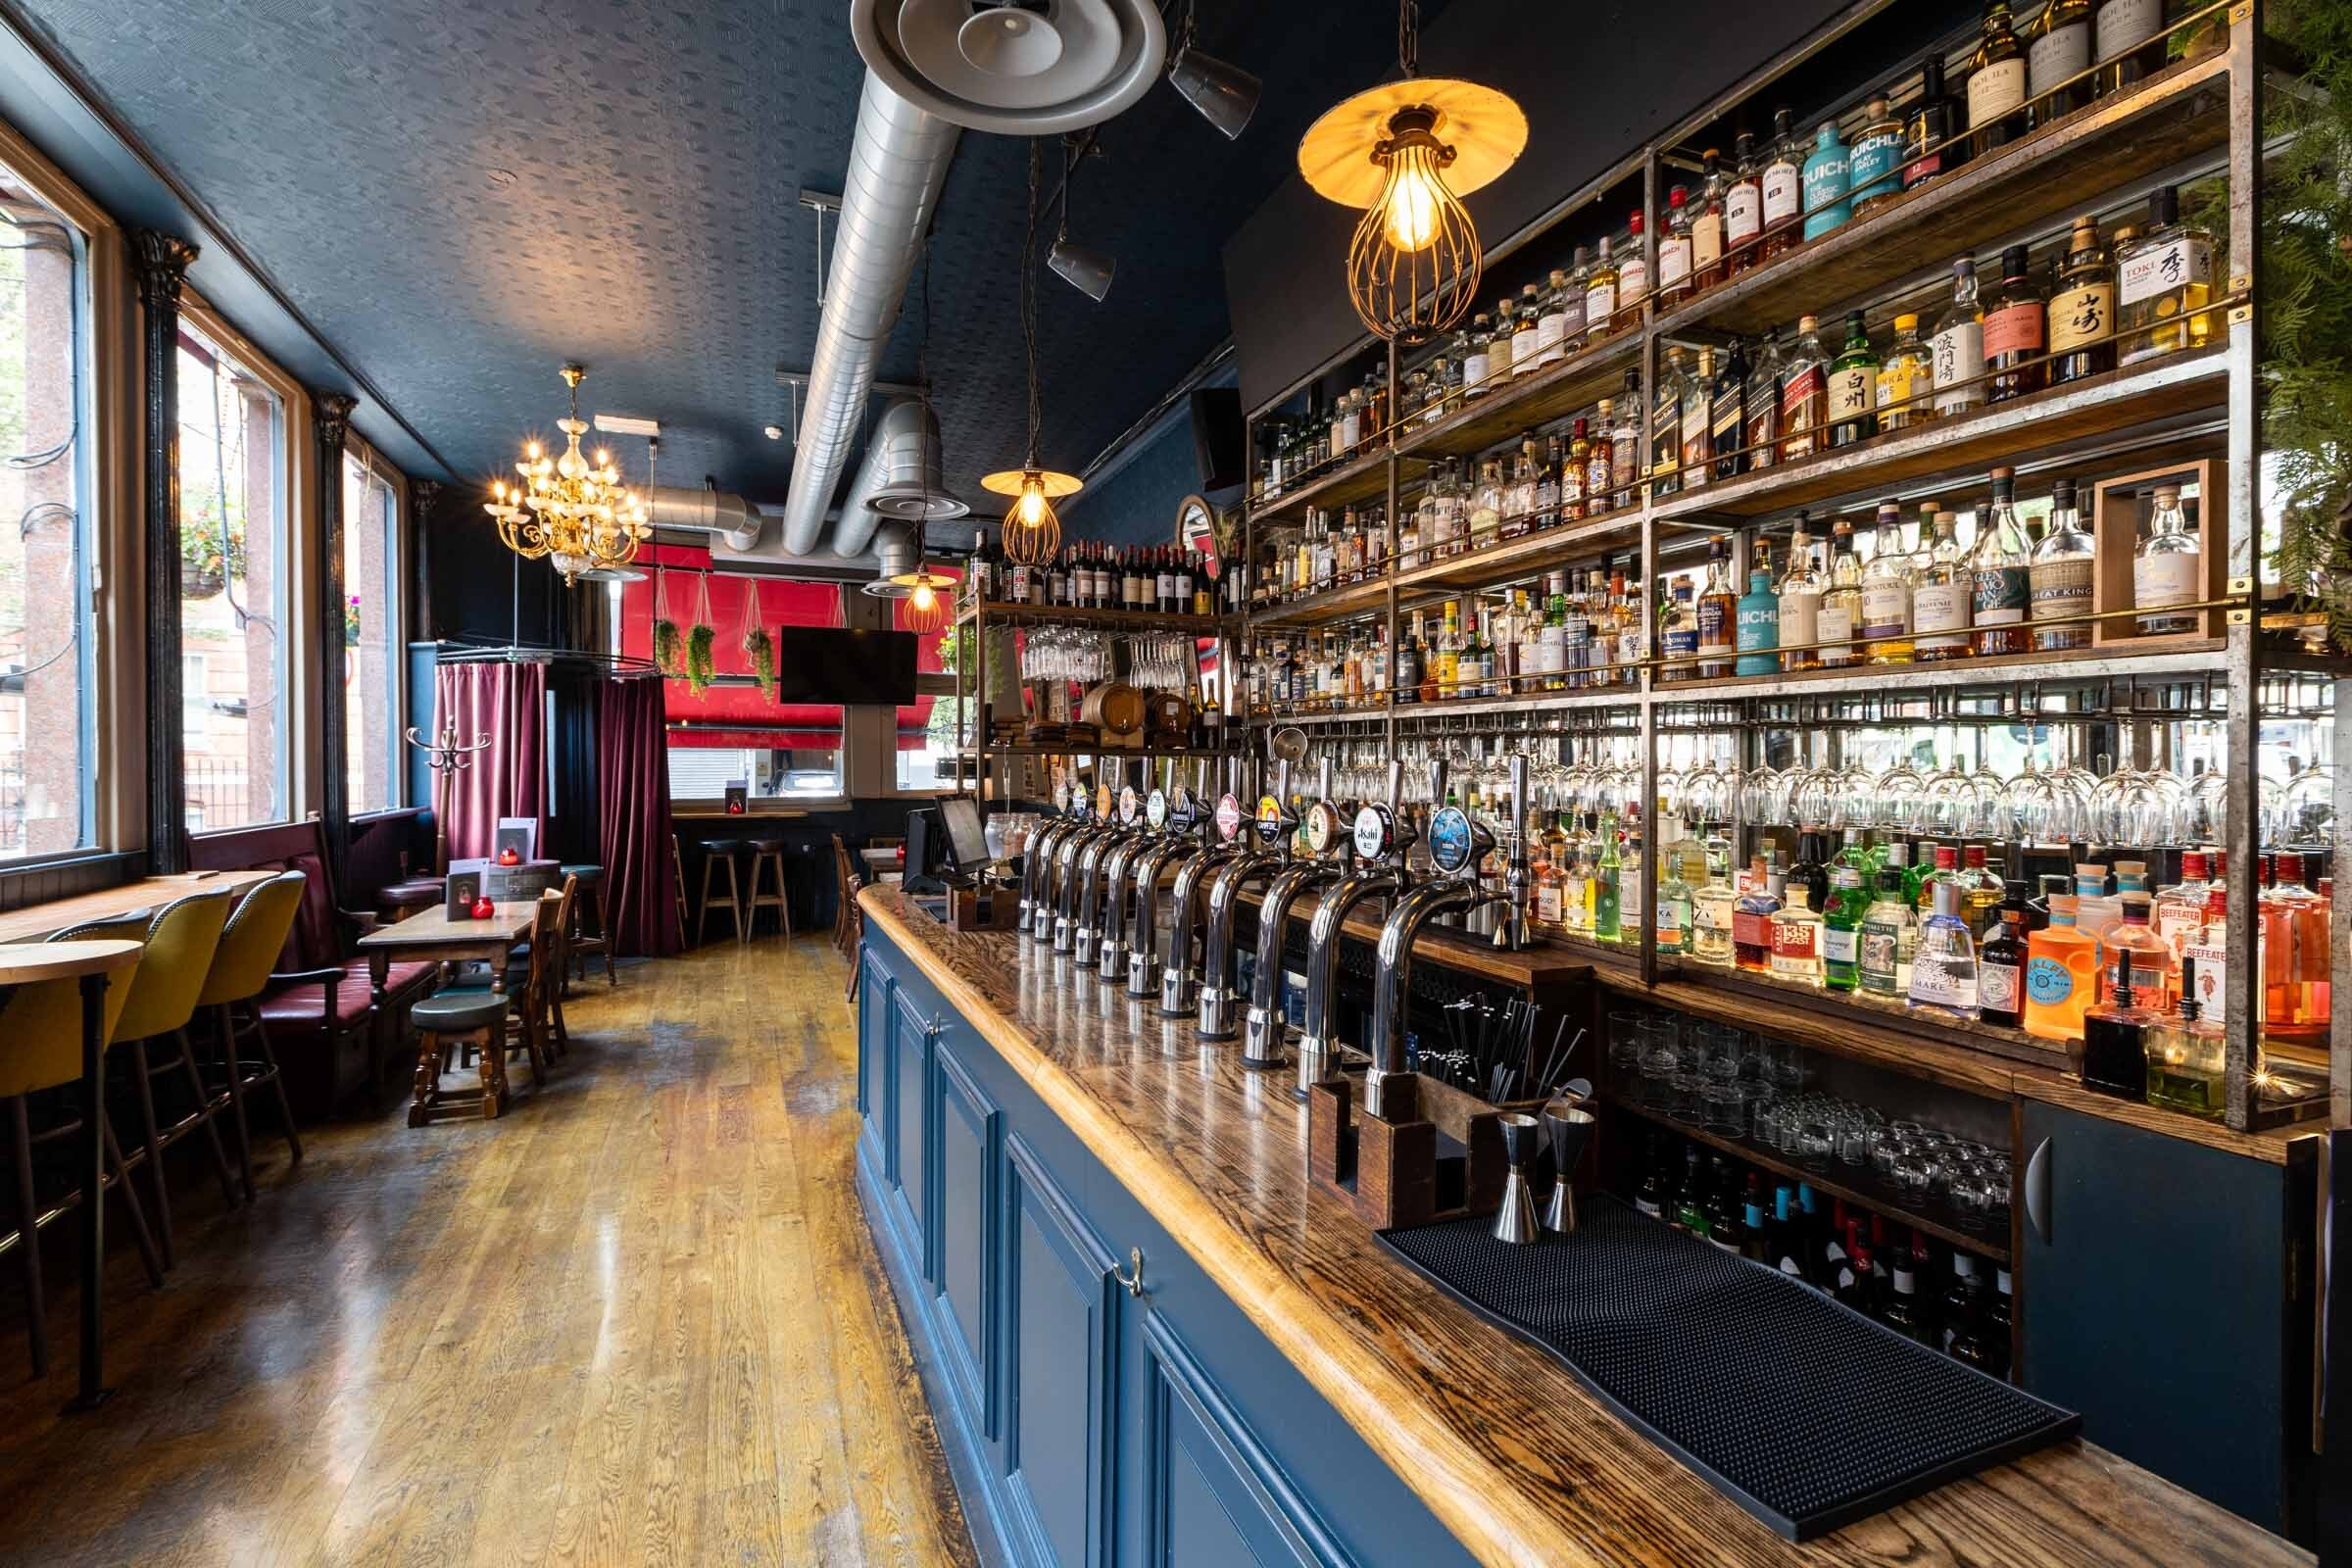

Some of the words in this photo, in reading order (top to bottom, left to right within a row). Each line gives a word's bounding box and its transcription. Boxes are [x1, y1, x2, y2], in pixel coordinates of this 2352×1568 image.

[2126, 261, 2155, 278] TOKI
[1845, 372, 1866, 408] 白州
[1975, 569, 2003, 583] GLEN
[1984, 579, 2005, 590] MO
[1976, 589, 1997, 602] RAN
[2063, 588, 2092, 597] KING
[1358, 827, 1378, 840] Asahi
[2160, 907, 2201, 922] BEEFEATER
[1783, 937, 1810, 946] EAST
[2186, 947, 2227, 961] BEEFEATE
